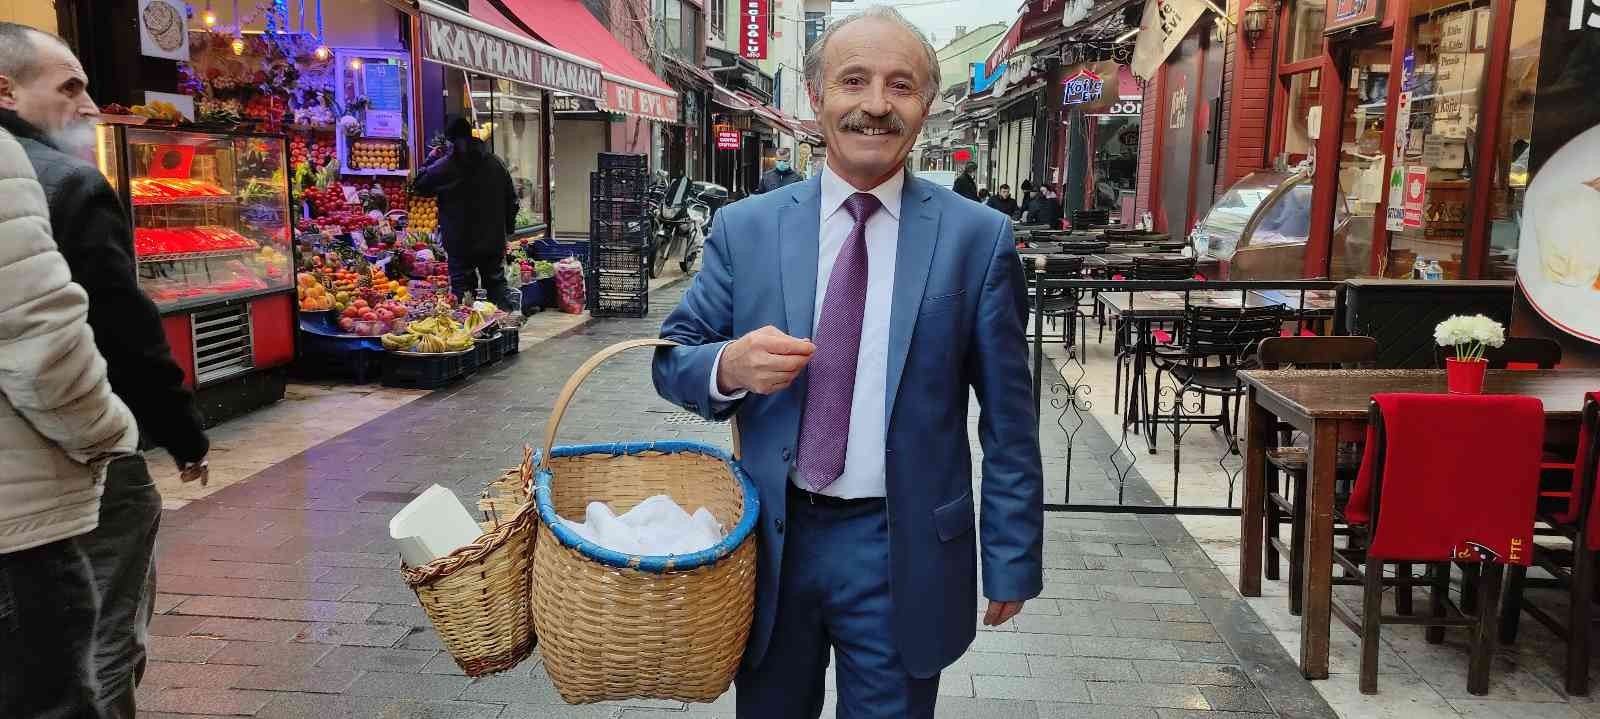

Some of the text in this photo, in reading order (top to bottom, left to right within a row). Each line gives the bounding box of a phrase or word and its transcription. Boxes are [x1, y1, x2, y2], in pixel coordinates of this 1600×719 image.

[430, 20, 601, 97] KAYHAN MANAVI
[616, 85, 635, 111] ET
